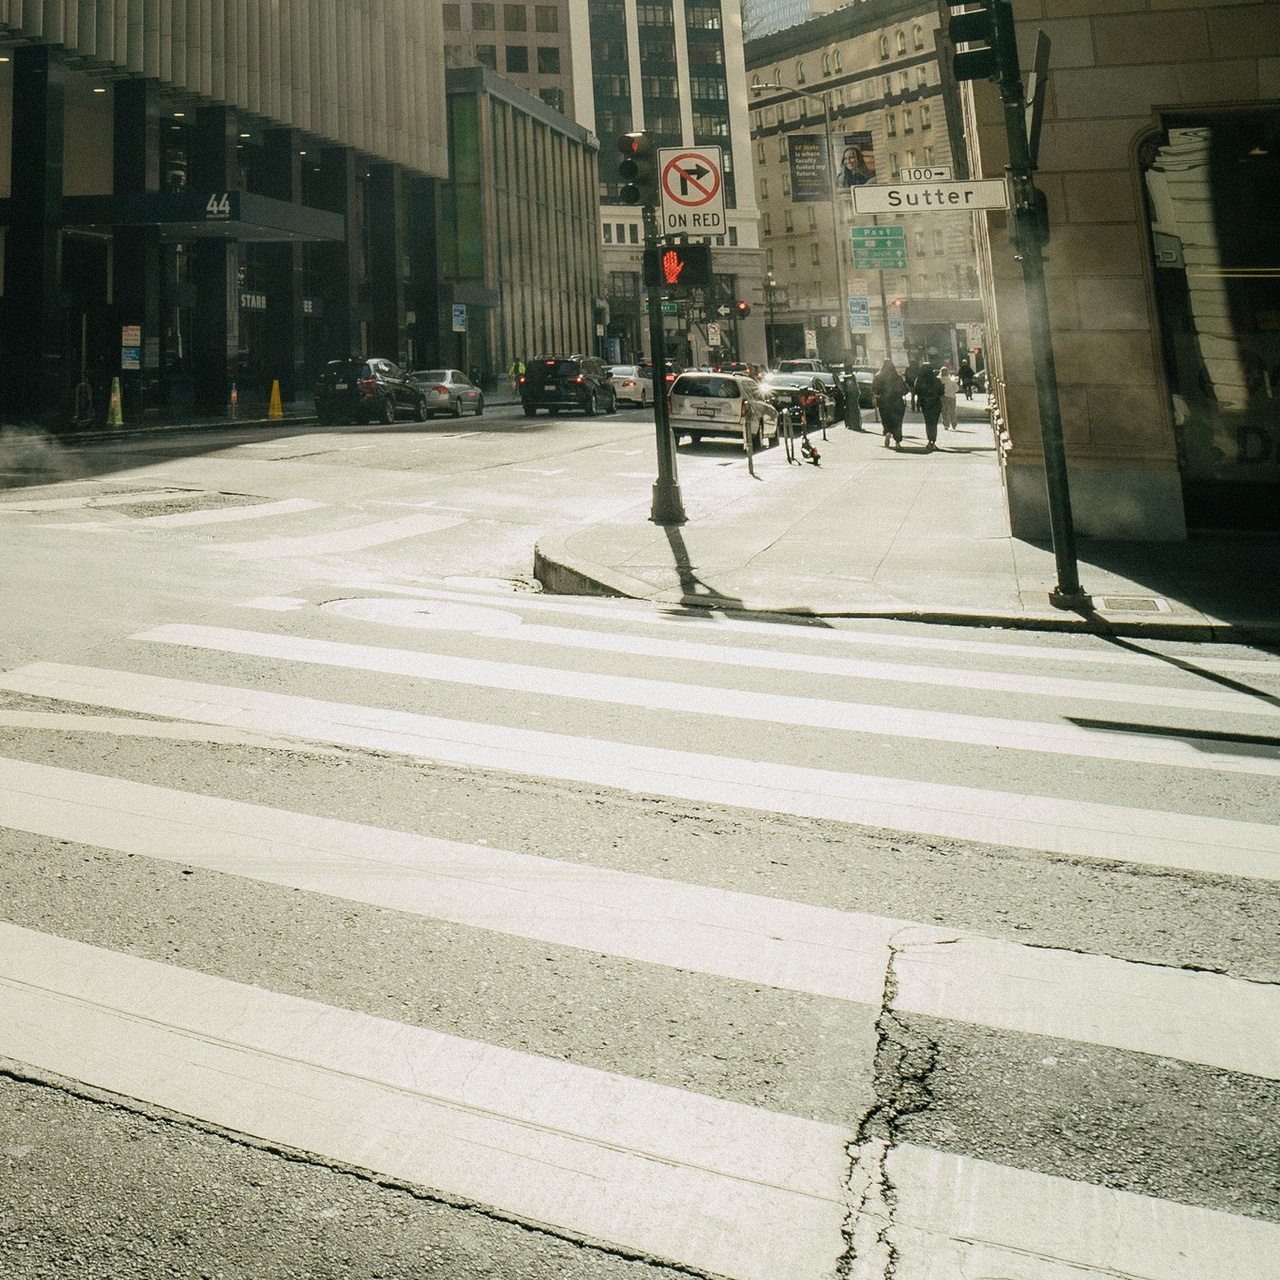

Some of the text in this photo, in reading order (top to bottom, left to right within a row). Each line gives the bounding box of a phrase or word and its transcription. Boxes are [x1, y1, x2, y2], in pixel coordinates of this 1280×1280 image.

[907, 169, 933, 181] 100
[206, 193, 231, 214] 44
[888, 189, 974, 207] Sutter
[668, 213, 720, 228] ON RED
[863, 228, 891, 236] Post
